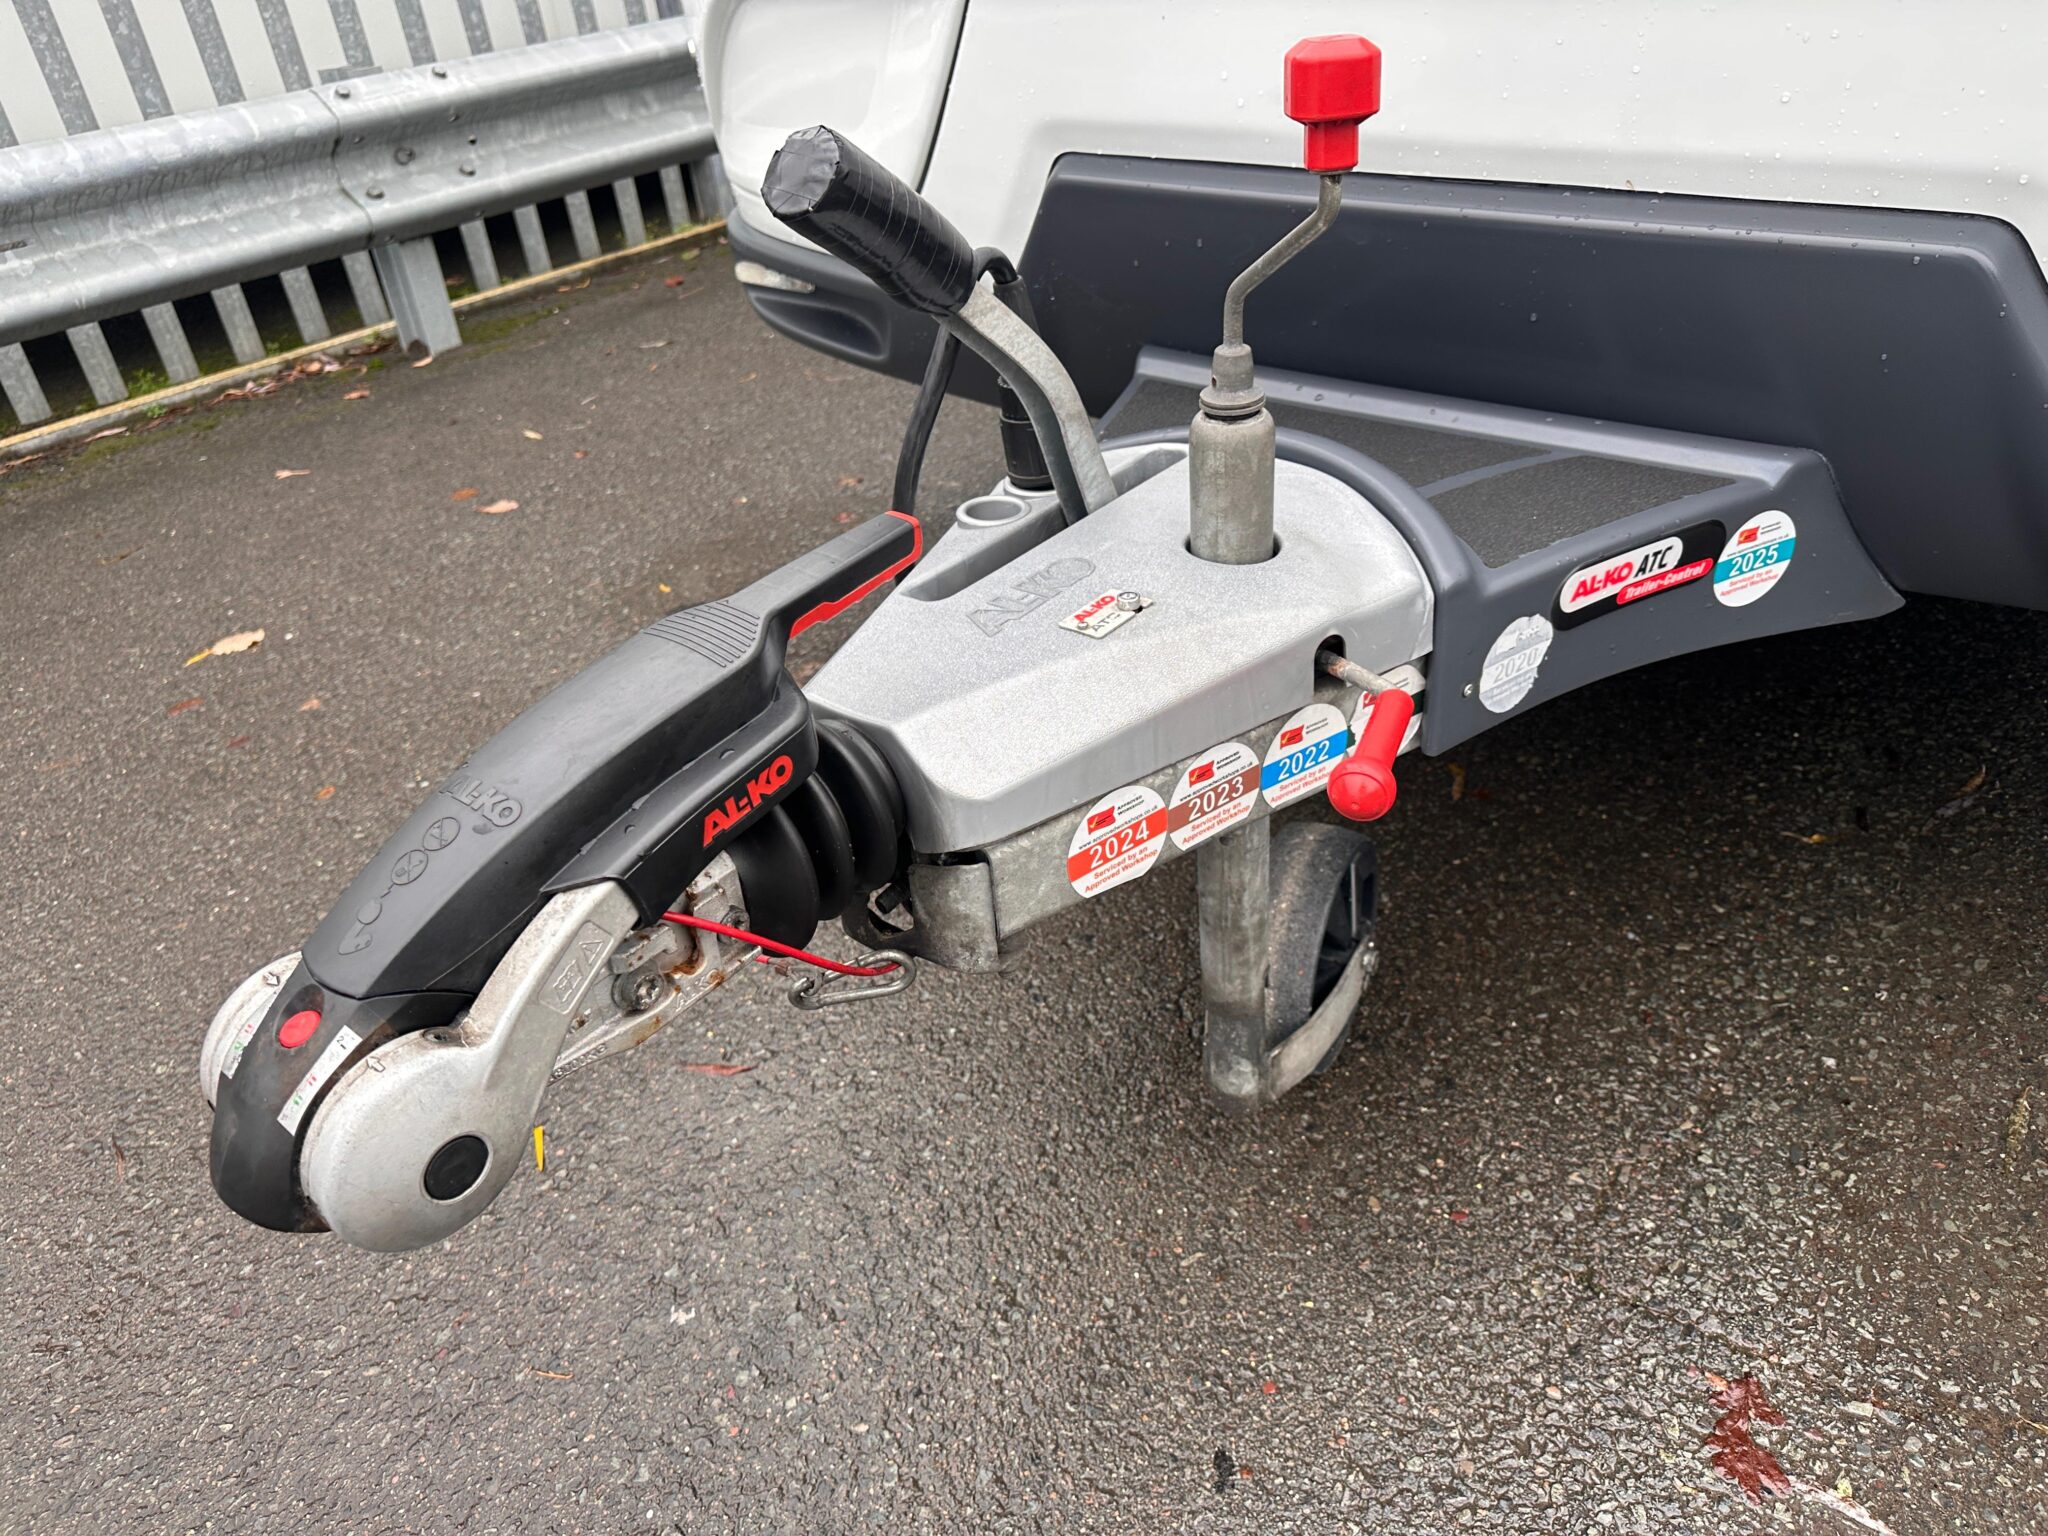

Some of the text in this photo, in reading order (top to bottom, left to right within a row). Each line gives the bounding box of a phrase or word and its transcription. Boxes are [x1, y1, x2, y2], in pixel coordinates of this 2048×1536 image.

[1570, 544, 1674, 603] AL-KO ATC
[1729, 544, 1780, 577] 2025
[966, 557, 1097, 638] AL-KO
[1625, 561, 1706, 600] Trailer-Control
[1074, 595, 1116, 624] AL-KO
[1494, 648, 1539, 683] 2020
[1278, 740, 1330, 781] 2022
[1280, 772, 1308, 791] Serviced
[1308, 769, 1317, 779] by
[438, 775, 523, 828] AL-KO
[703, 754, 794, 849] AL-KO
[1188, 776, 1244, 821] 2023
[1270, 772, 1331, 804] Approved Worksho
[1182, 805, 1251, 844] Approved Workshop
[1191, 801, 1242, 832] Serviced by an
[1089, 820, 1150, 870] 2024
[1094, 846, 1148, 879] Serviced by an
[1085, 849, 1158, 893] Approved Workshop
